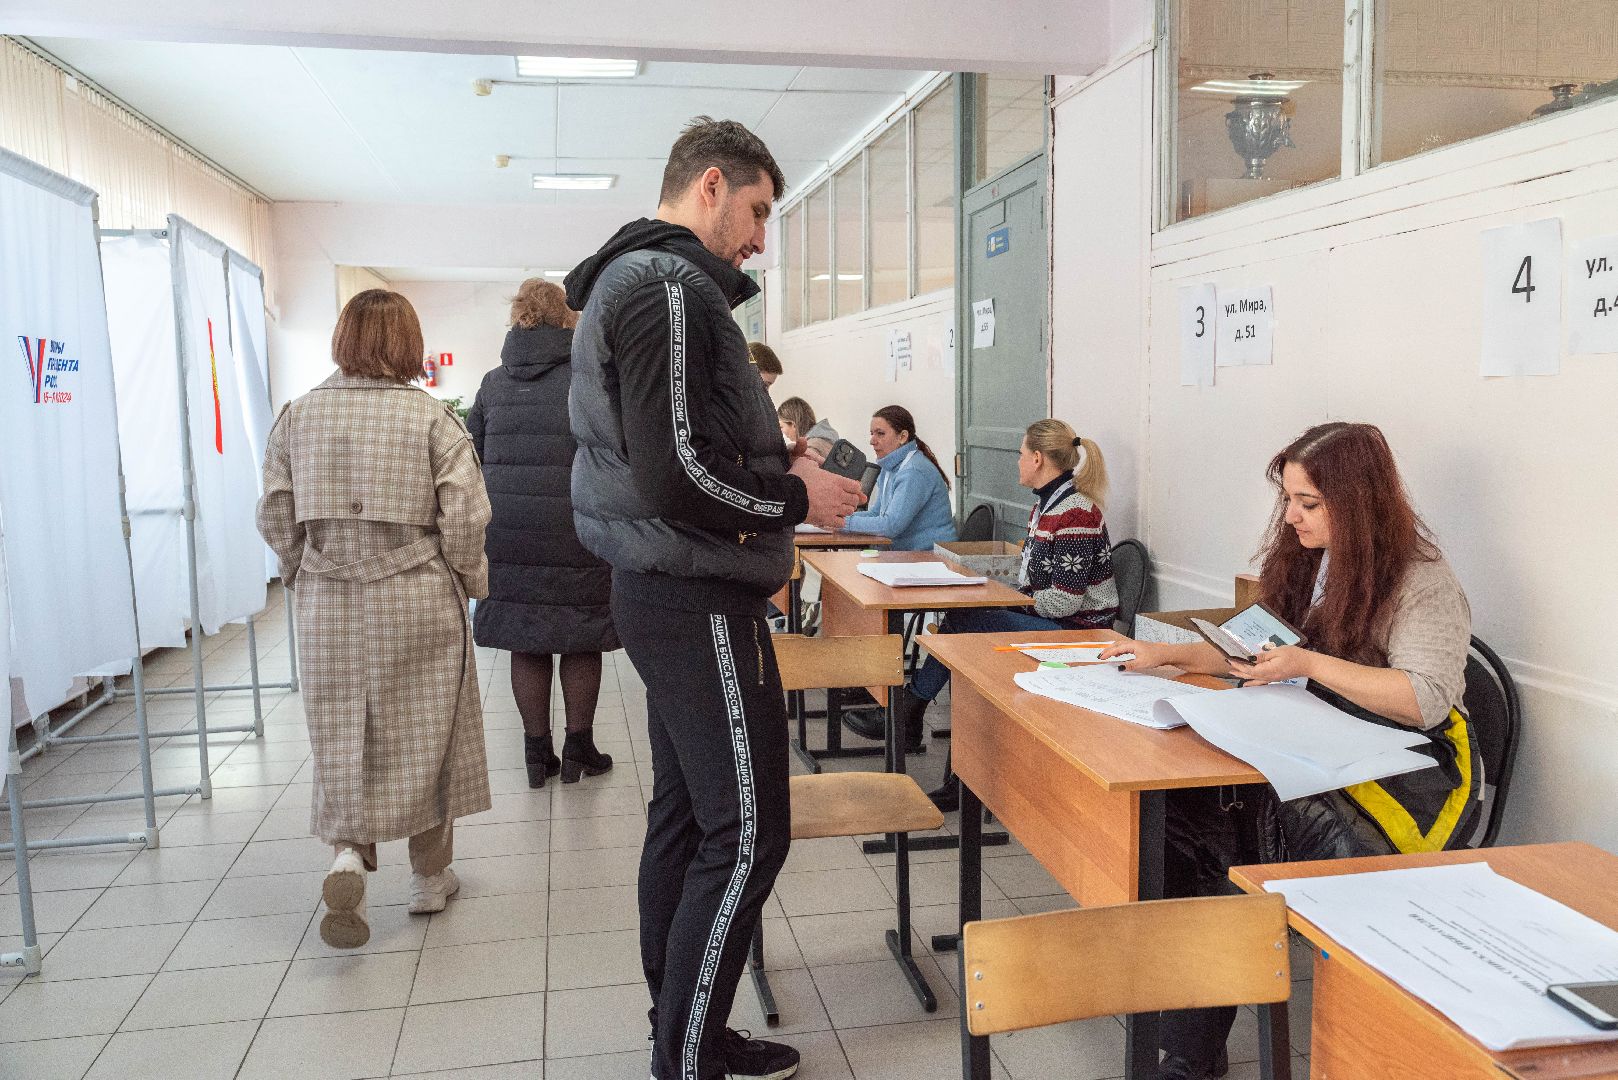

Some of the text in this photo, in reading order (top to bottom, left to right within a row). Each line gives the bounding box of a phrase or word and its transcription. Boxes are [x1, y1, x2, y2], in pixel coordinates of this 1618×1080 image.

[1511, 255, 1536, 303] 4
[1585, 257, 1613, 279] ул.
[1195, 305, 1205, 338] 3
[1224, 298, 1267, 318] ул. Мира,
[1234, 324, 1256, 342] д. 51
[670, 286, 685, 422] ФЕДЕРАЦИЯ БОКСА РОССИИ
[700, 476, 720, 495] БОКСА
[720, 490, 750, 507] РОССИИ
[719, 647, 732, 678] БОКСА
[726, 680, 741, 720] РОССИИ
[734, 726, 753, 856] ФЕДЕРАЦИЯ БОКСА РОССИИ
[702, 862, 748, 986] ФЕДЕРАЦИЯ БОКСА РОССИИ
[688, 991, 707, 1043] ФЕДЕРАЦИЯ
[685, 1042, 695, 1072] БОКСА
